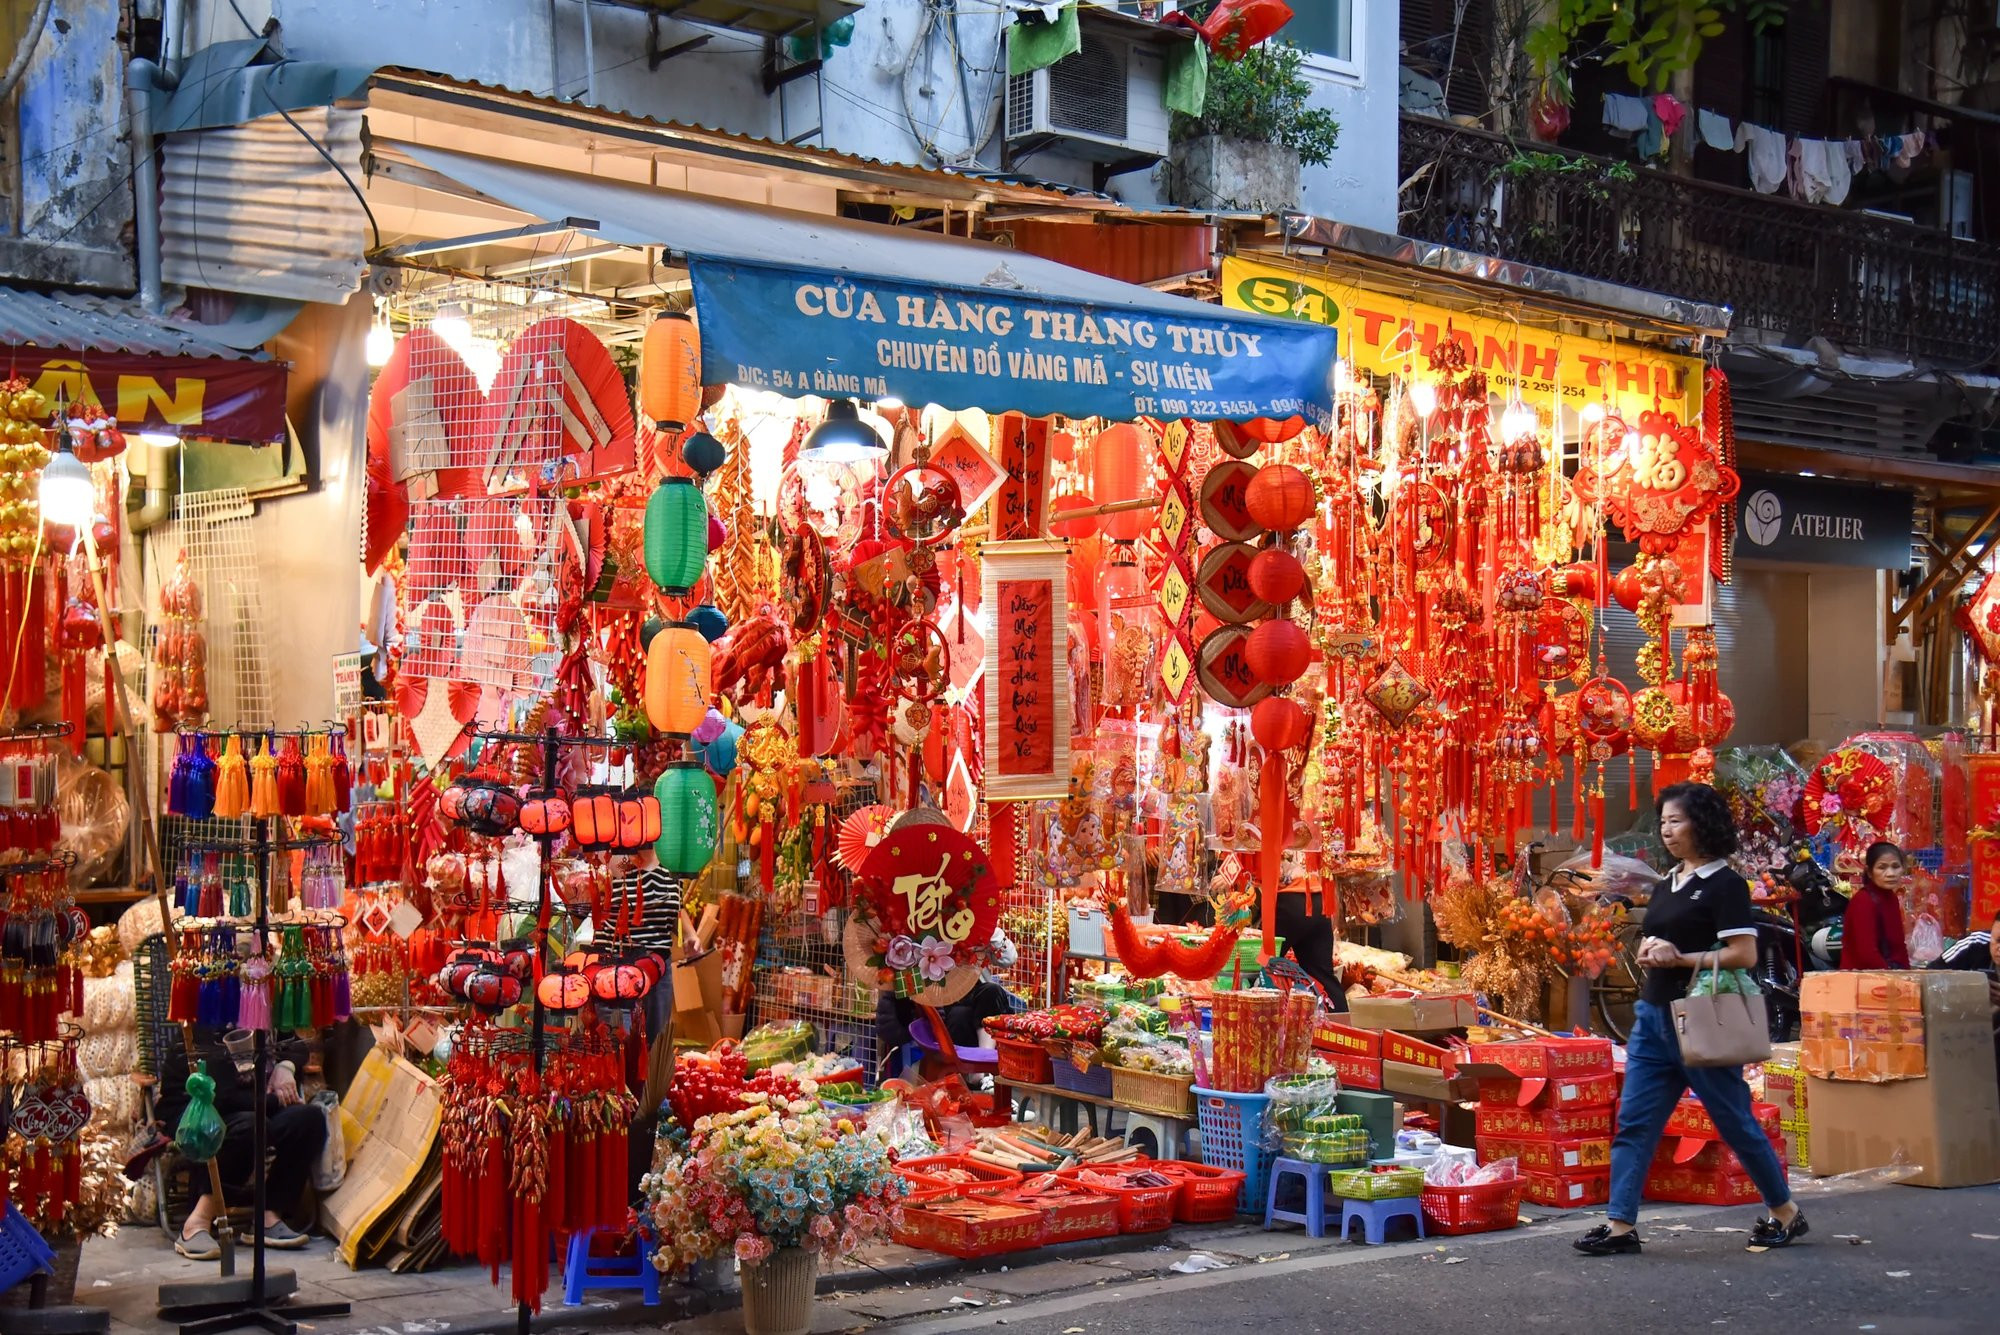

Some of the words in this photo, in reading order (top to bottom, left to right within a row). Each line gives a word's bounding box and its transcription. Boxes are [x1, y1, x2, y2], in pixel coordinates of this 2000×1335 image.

[795, 276, 886, 323] CỬA
[896, 290, 1014, 336] HÀNG
[1252, 280, 1327, 324] 54
[1354, 308, 1558, 380] THANH
[773, 369, 793, 388] 54
[800, 371, 809, 390] A
[814, 369, 860, 393] HÀNG
[864, 375, 887, 396] MÃ
[877, 338, 968, 374] CHUYÊN
[973, 341, 1001, 377] ĐỒ
[1007, 347, 1068, 382] VÀNG
[1073, 354, 1108, 385] MÃ
[1131, 360, 1159, 392] SỰ
[1162, 361, 1213, 394] KIỆN
[1161, 398, 1188, 414] 090
[1191, 399, 1219, 415] 322
[1221, 400, 1258, 415] 5454
[1271, 398, 1304, 414] 0945
[1533, 380, 1558, 394] 295
[1562, 384, 1586, 398] 254
[1791, 513, 1864, 540] ATELIER
